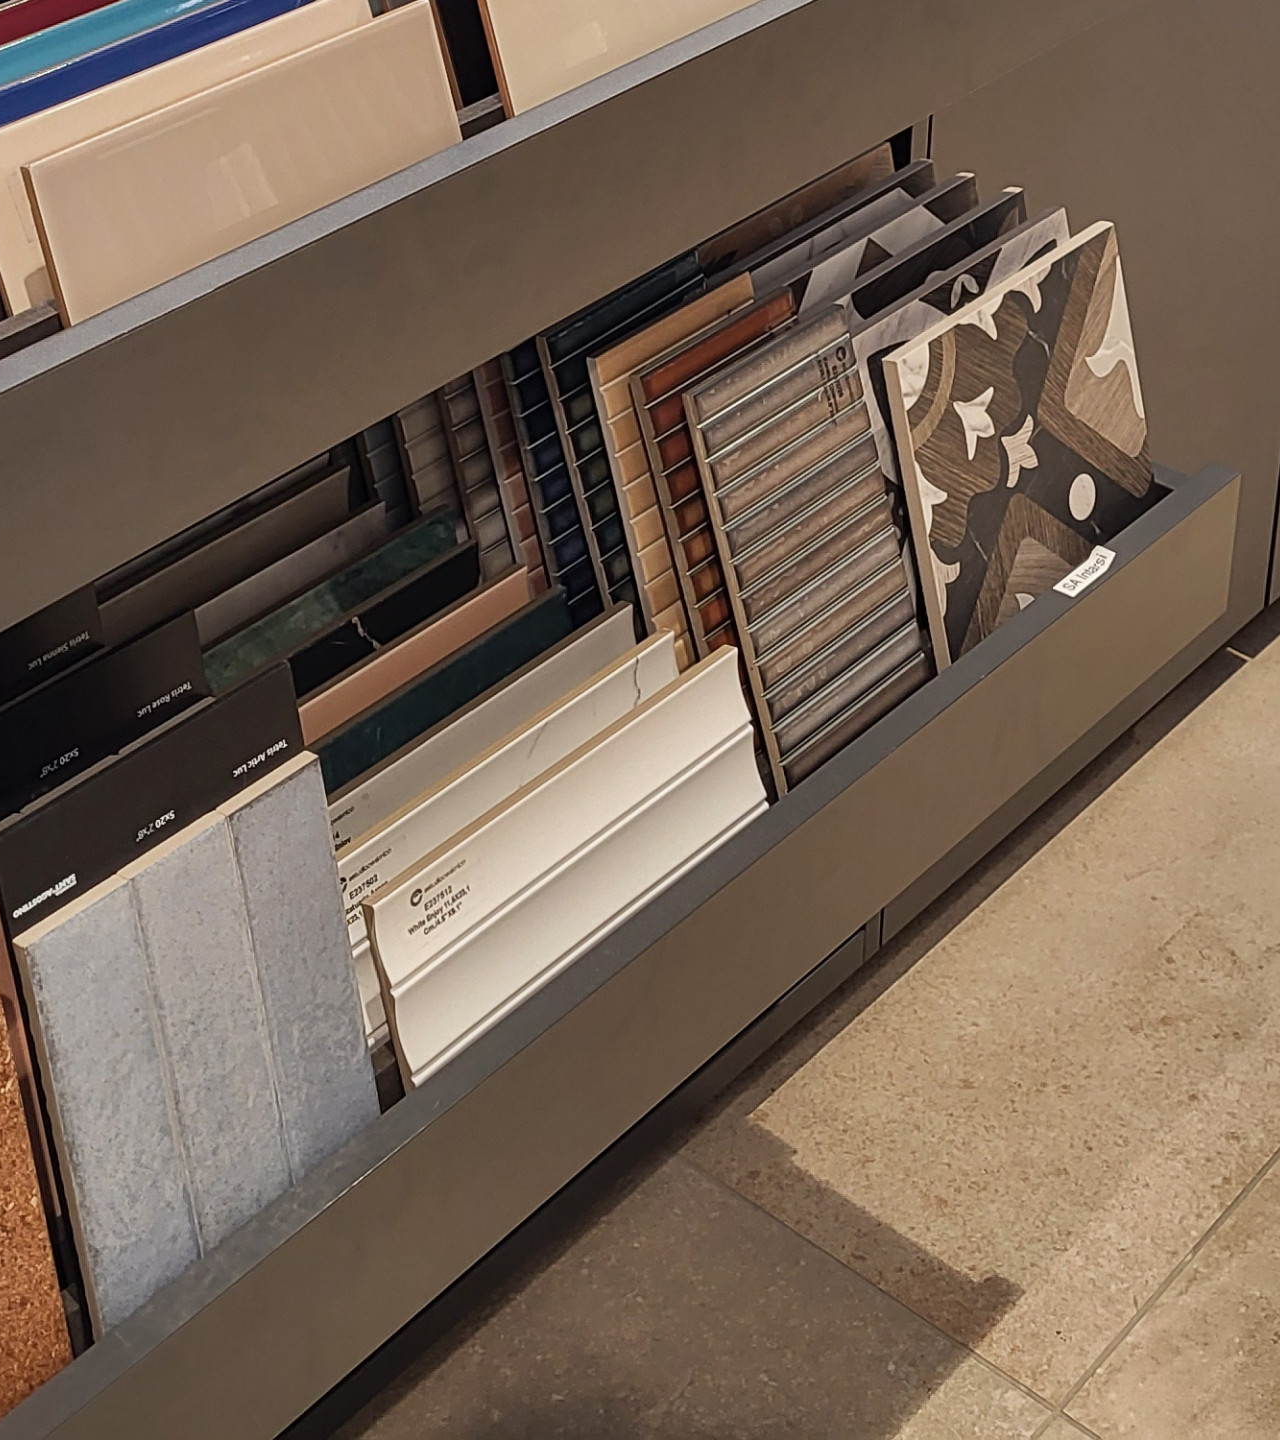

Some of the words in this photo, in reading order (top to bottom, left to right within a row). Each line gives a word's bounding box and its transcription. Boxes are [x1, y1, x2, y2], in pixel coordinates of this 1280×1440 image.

[1063, 579, 1082, 591] SA
[1076, 553, 1108, 580] Intarsi
[172, 681, 192, 698] Tetris
[136, 704, 152, 718] Luc
[152, 693, 171, 710] Rose
[59, 747, 80, 765] 5x20
[267, 738, 288, 758] Tetris
[232, 764, 248, 778] Luc
[246, 752, 267, 771] Artic
[154, 809, 175, 828] 5x20
[424, 885, 453, 911] E237512
[407, 918, 426, 936] White
[426, 905, 444, 922] Enjoy
